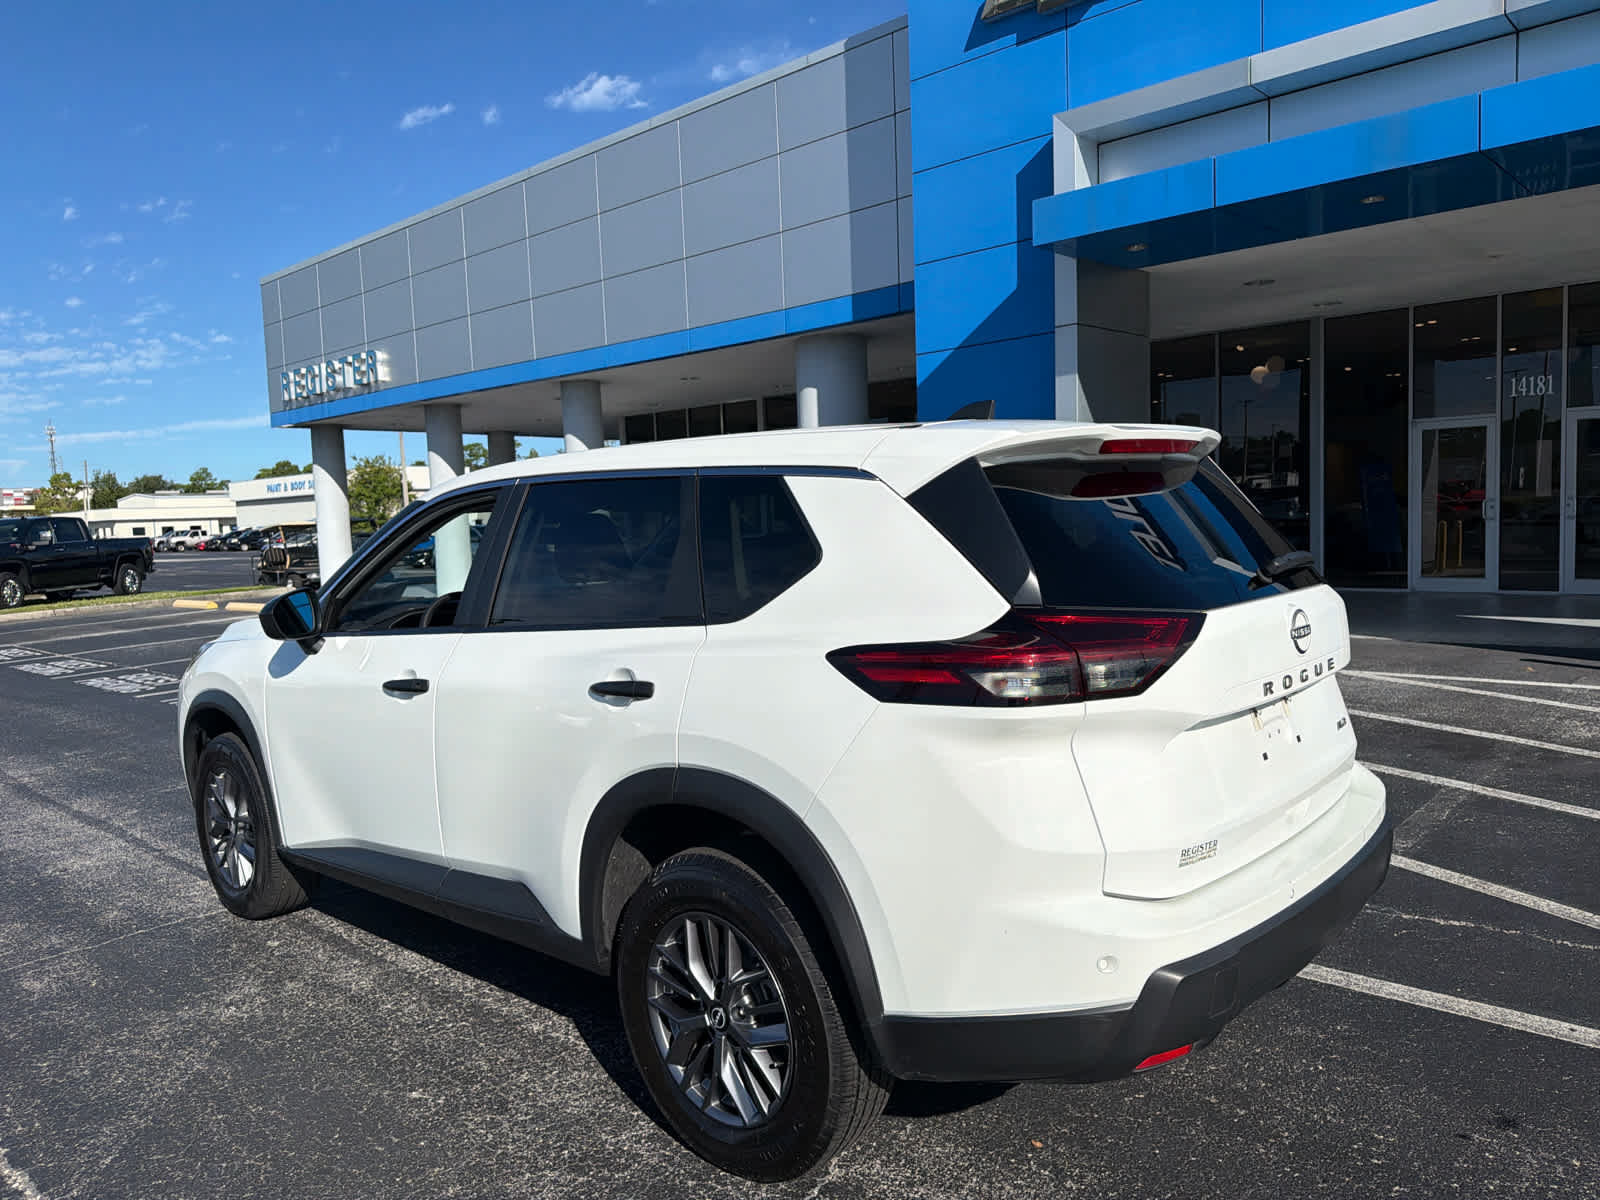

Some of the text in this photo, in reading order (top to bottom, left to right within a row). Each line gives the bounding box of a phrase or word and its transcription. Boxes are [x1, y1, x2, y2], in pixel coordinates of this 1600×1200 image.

[281, 350, 379, 400] REGISTER
[1509, 374, 1555, 398] 14181
[266, 483, 282, 493] PAINT
[290, 480, 306, 491] BODY
[1262, 657, 1335, 697] ROGUE
[1180, 839, 1218, 858] REGISTER
